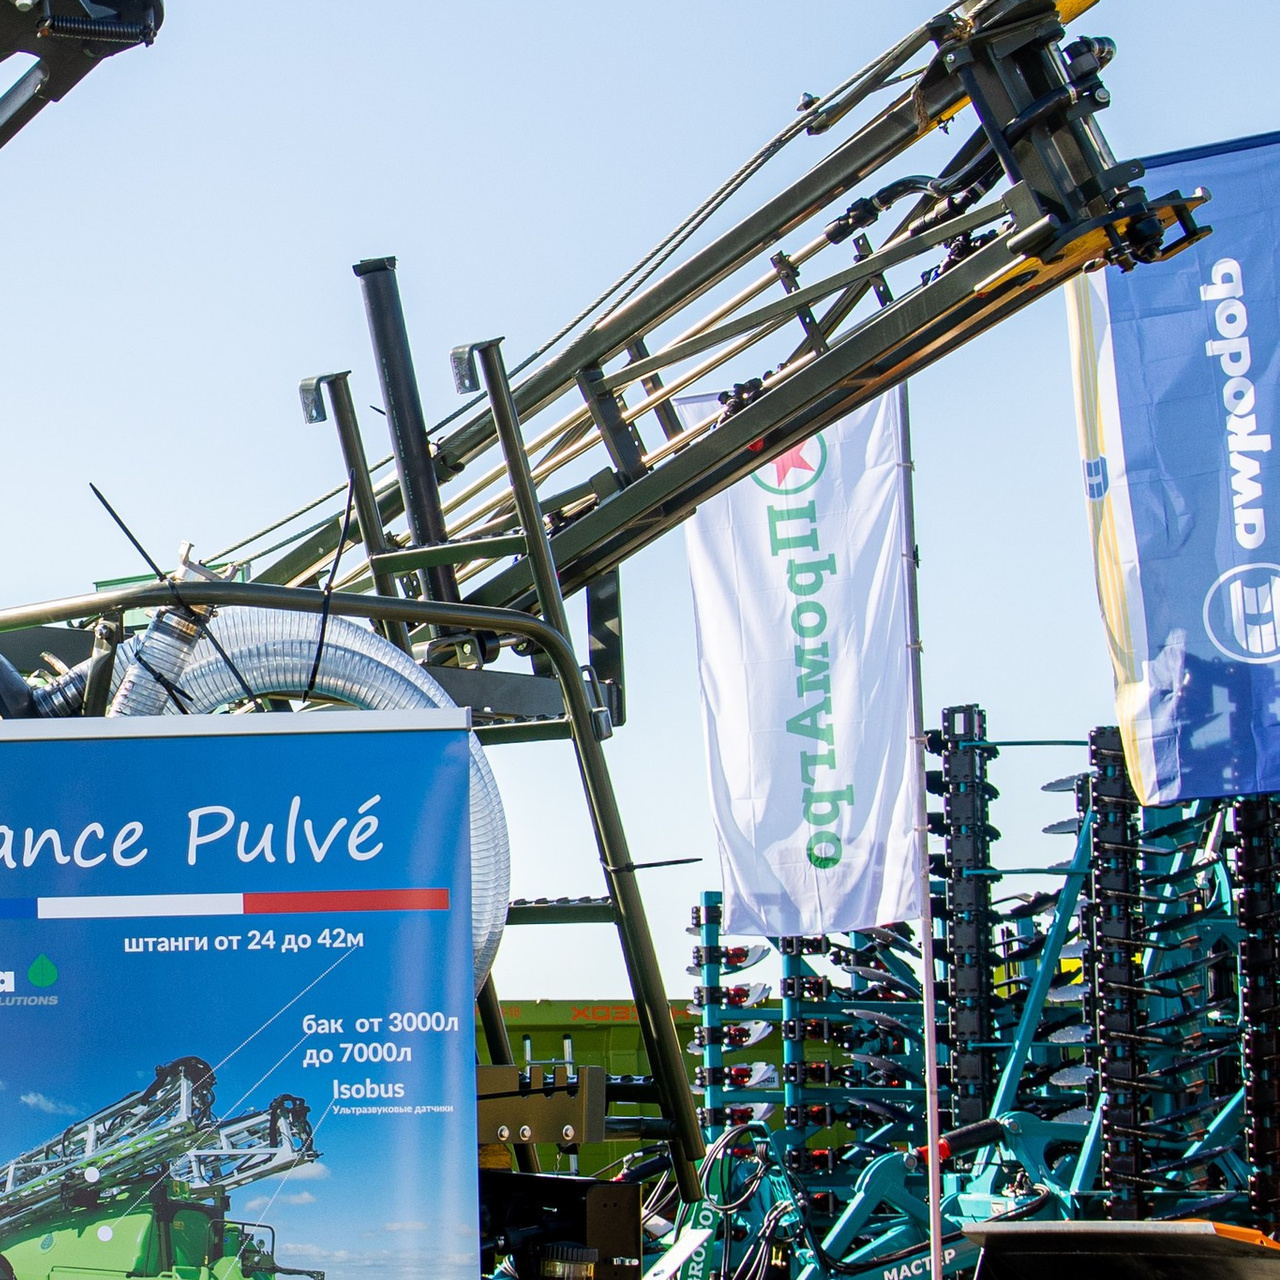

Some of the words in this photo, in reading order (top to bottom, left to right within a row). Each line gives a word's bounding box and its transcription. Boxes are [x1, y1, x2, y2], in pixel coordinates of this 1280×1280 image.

[186, 794, 384, 866] Pulvé
[124, 936, 208, 952] штанги
[214, 935, 241, 951] от
[247, 930, 276, 950] 24
[281, 933, 311, 953] до
[317, 928, 363, 948] 42м
[303, 1014, 344, 1034] бак
[355, 1018, 383, 1033] от
[389, 1012, 459, 1032] 3000л
[303, 1048, 333, 1068] до
[339, 1042, 412, 1063] 7000л
[333, 1078, 405, 1099] Isobus
[332, 1105, 412, 1115] Ультразвуковые
[414, 1104, 454, 1114] датчики
